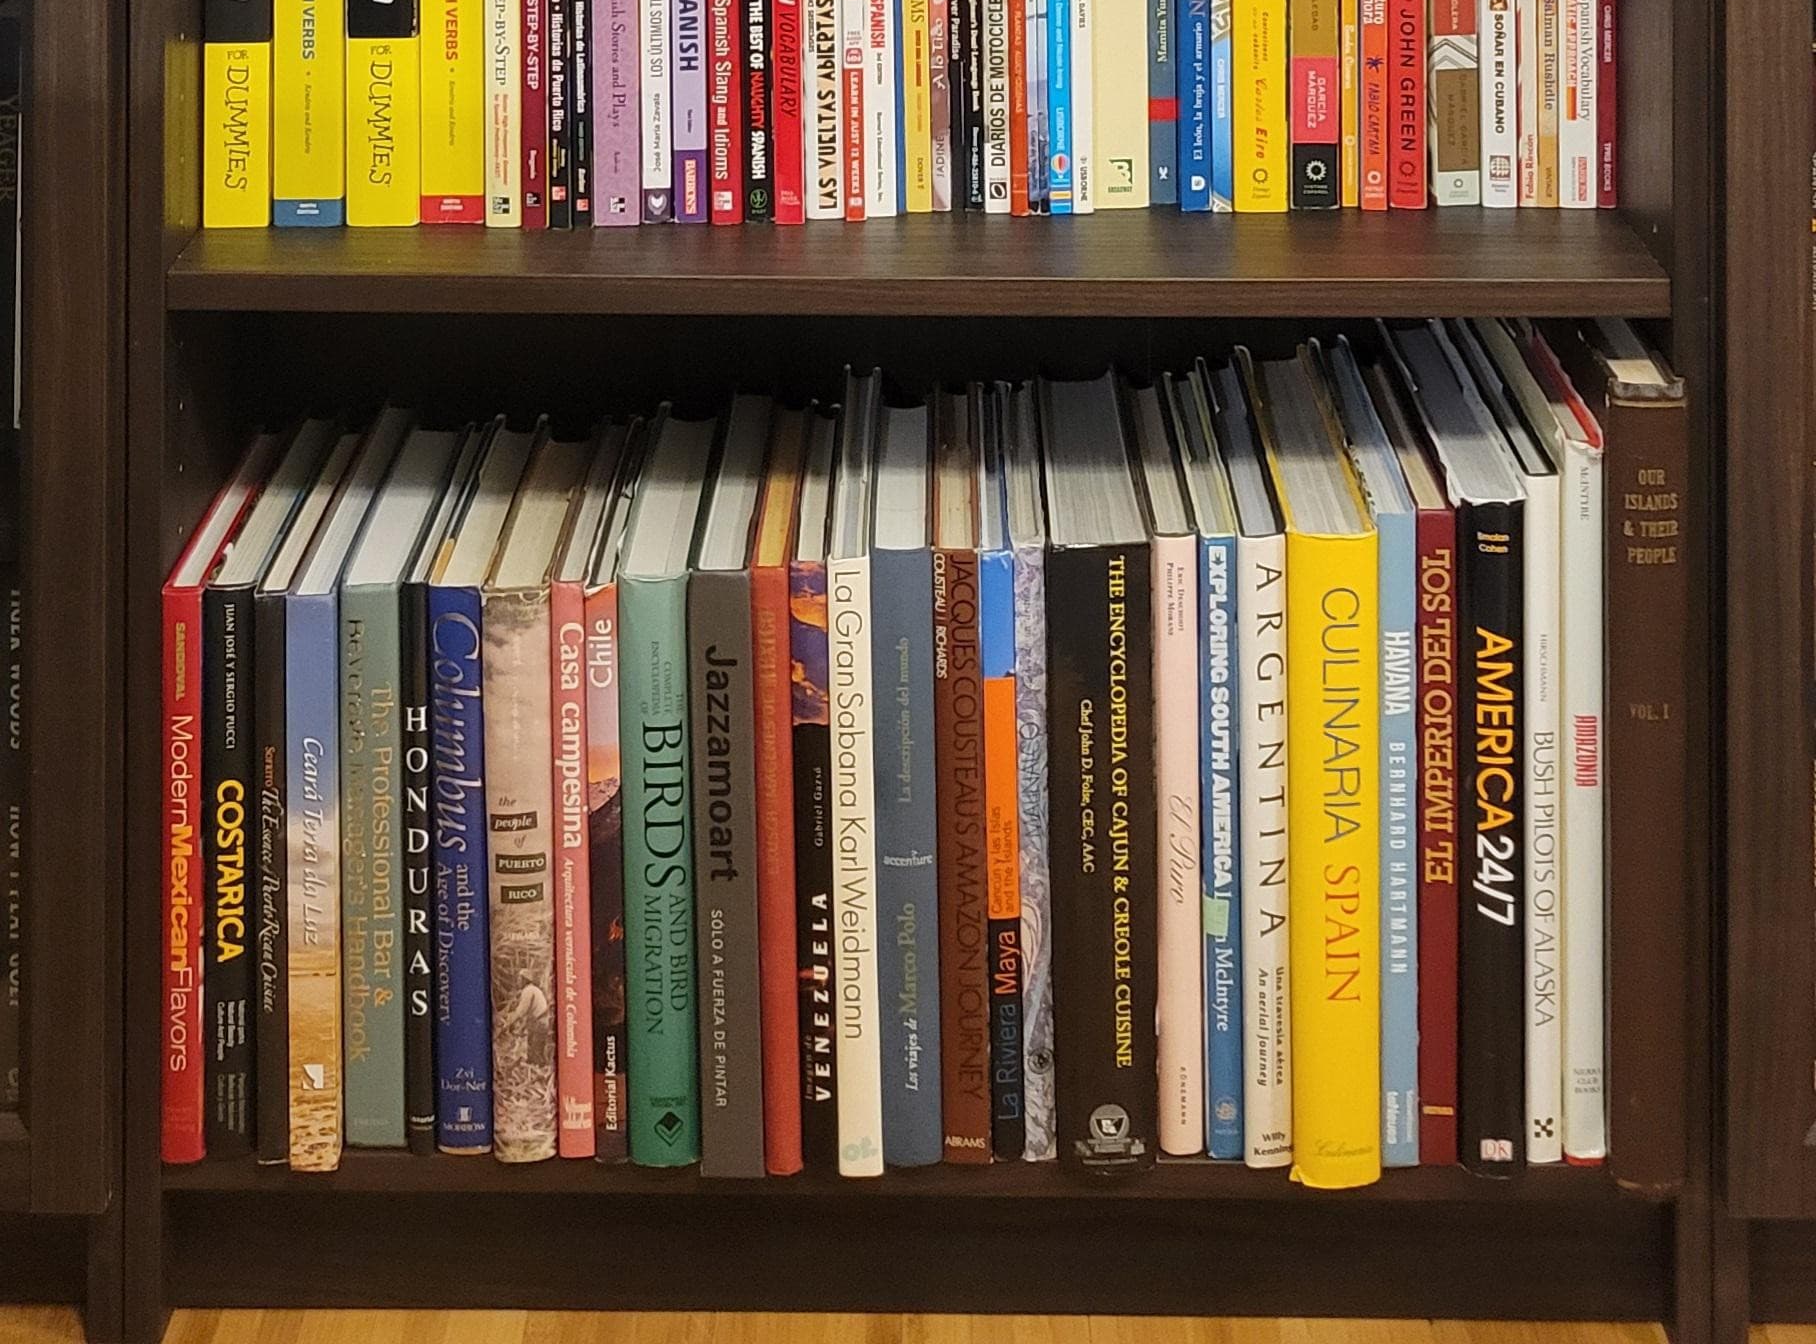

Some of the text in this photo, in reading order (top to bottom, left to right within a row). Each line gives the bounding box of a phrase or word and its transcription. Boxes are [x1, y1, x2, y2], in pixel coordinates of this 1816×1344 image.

[302, 7, 314, 60] VERBS
[776, 12, 795, 117] VOCABULARY
[1400, 9, 1415, 151] JOHN GREEN
[1492, 14, 1504, 57] SOÑAR
[1492, 61, 1504, 78] EN
[1579, 47, 1593, 121] Vocabulary
[224, 66, 250, 189] DUMMIES
[368, 61, 393, 185] DUMMIES
[1492, 81, 1504, 134] CUBANO
[1624, 494, 1678, 510] ISLANDS
[1624, 521, 1678, 537] & THEIR
[1638, 469, 1665, 486] OUR
[1628, 547, 1676, 563] PEOPLE
[433, 610, 482, 852] Columbus
[559, 622, 584, 848] Casa campesina
[704, 645, 738, 882] Jazzamoart
[1255, 563, 1285, 937] ARGENTINA
[1573, 715, 1598, 787] AMAZONIA
[642, 721, 685, 888] BIRDS
[835, 570, 866, 1040] La Gran Sabana Karl Weidmann
[1110, 556, 1129, 1067] THE ENCYCLOPEDIA OF CAJUN & CREOLE CUISINE
[1322, 588, 1360, 1002] CULINARIA SPAIN
[406, 706, 428, 1016] HONDURAS
[1532, 731, 1555, 1027] BUSH PILOTS OF ALASKA
[812, 894, 831, 1101] VENEZUELA
